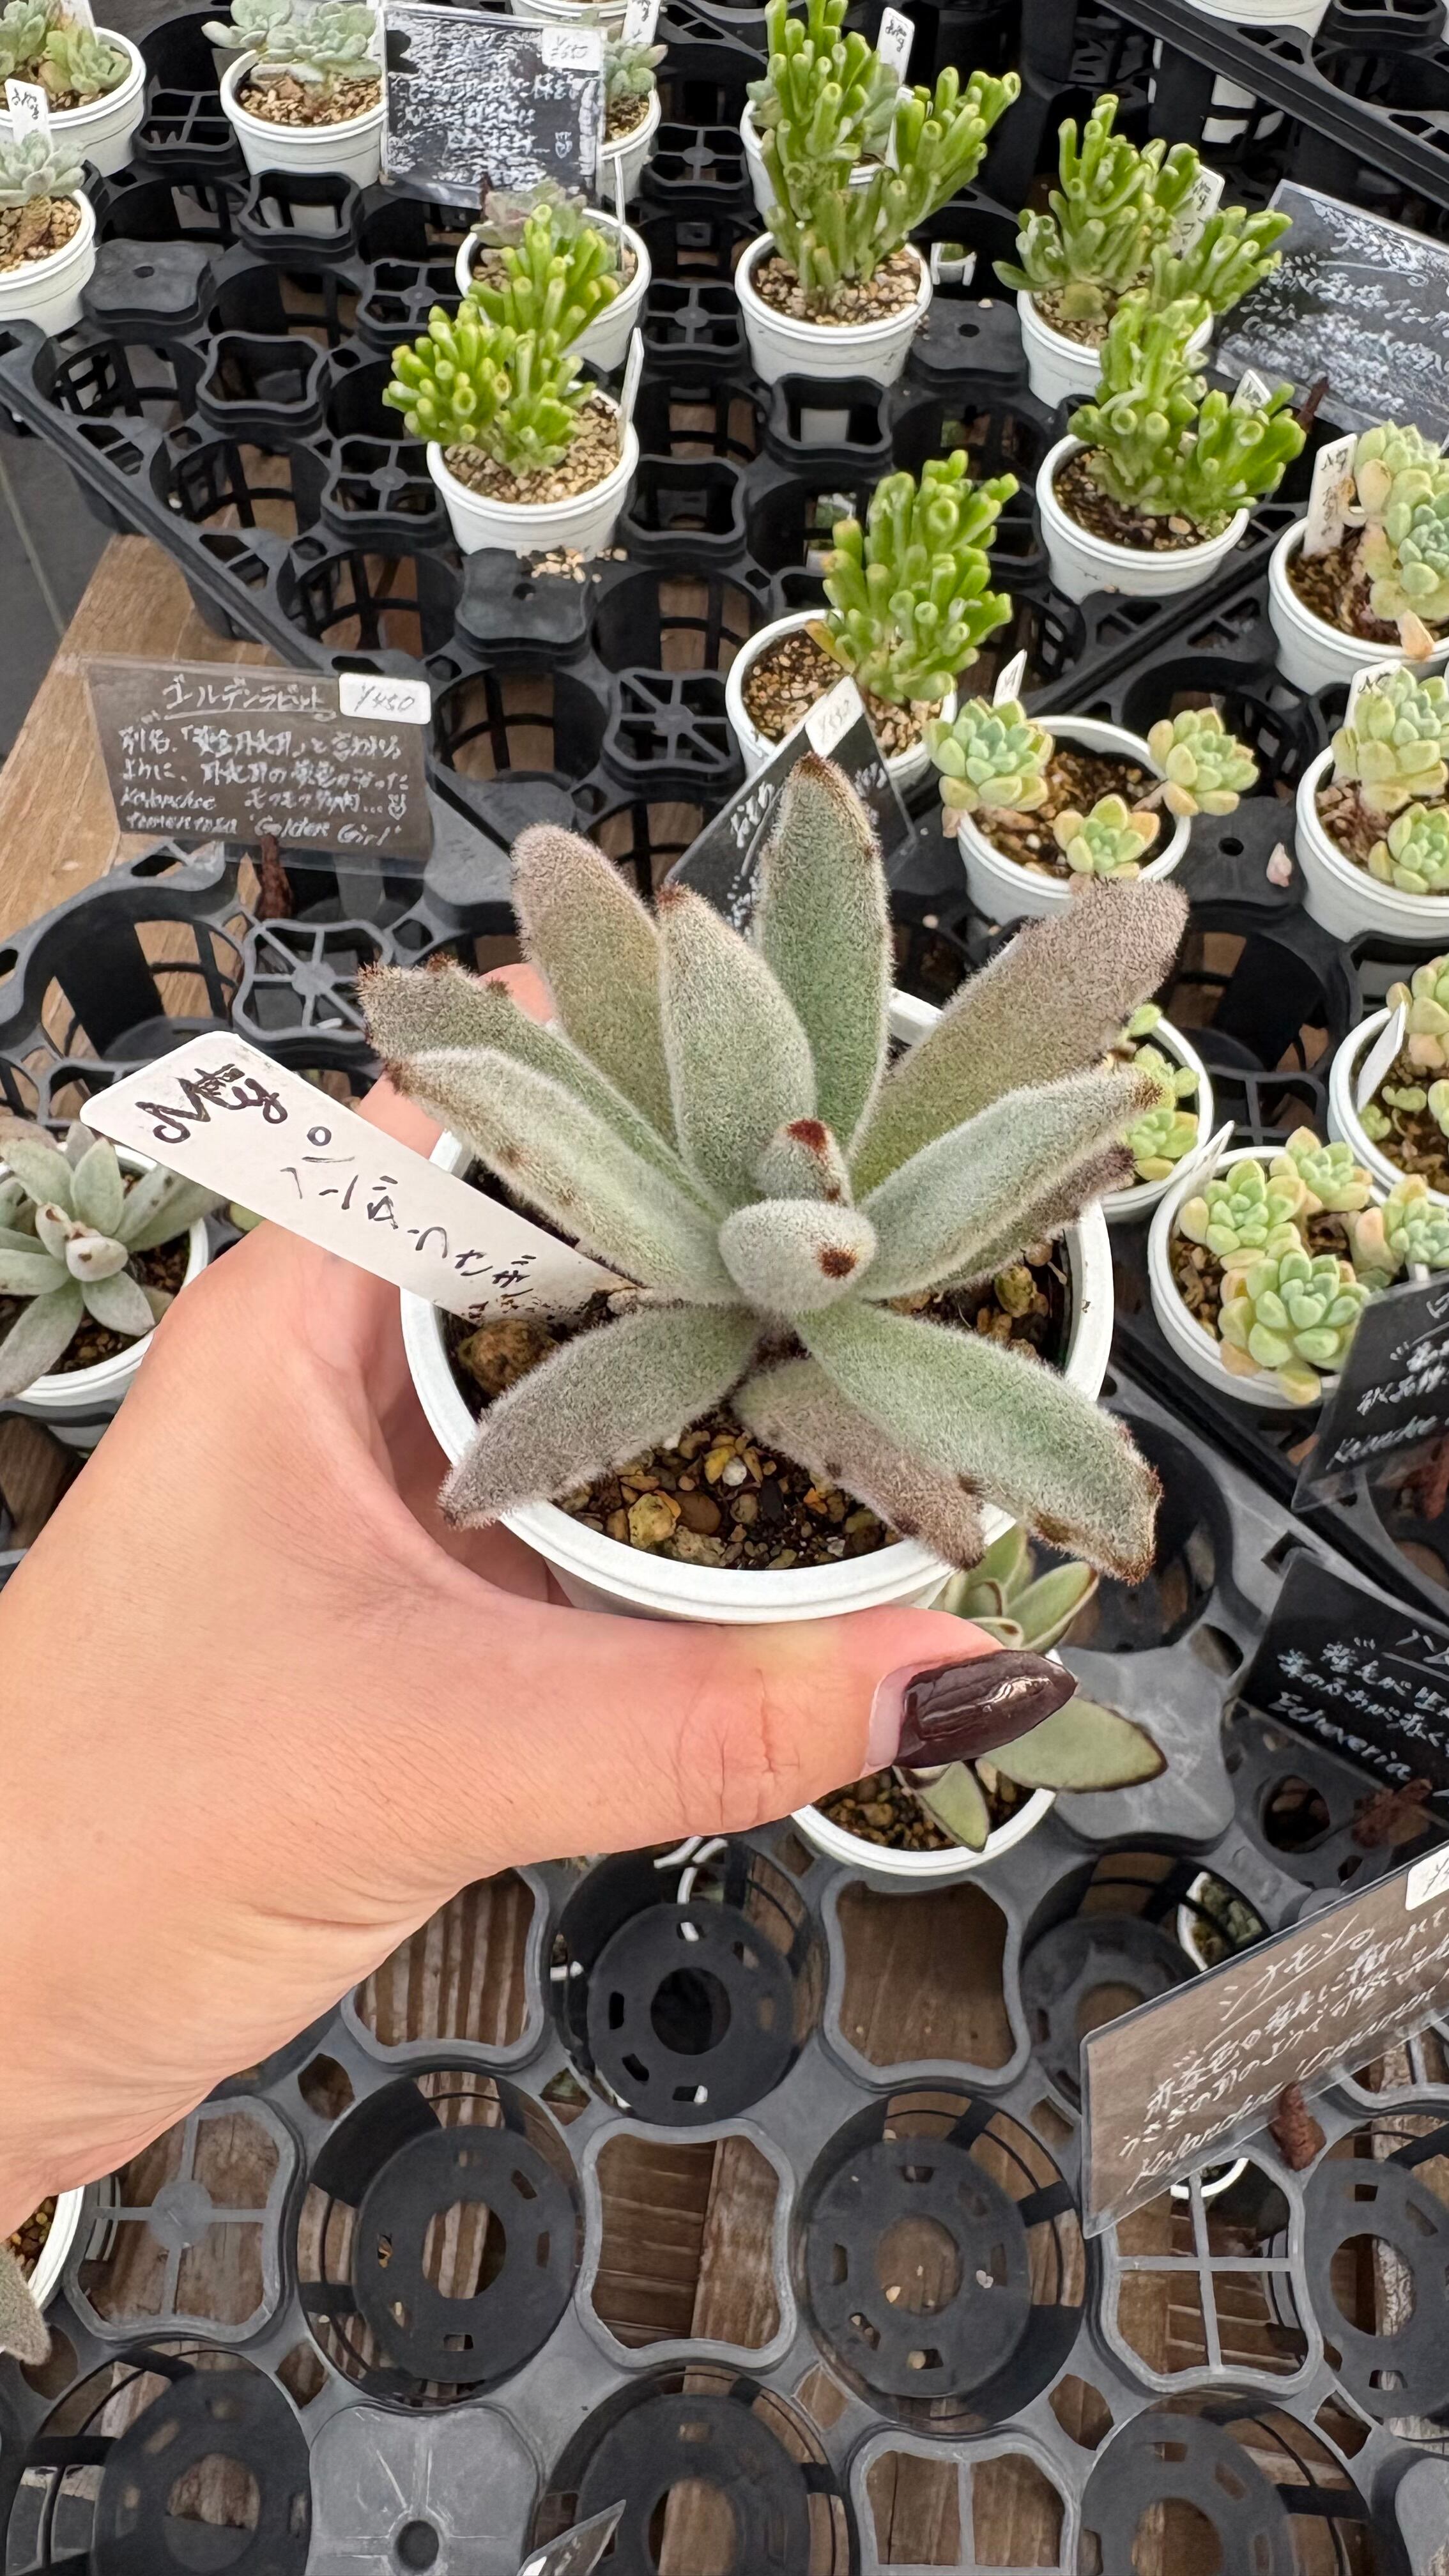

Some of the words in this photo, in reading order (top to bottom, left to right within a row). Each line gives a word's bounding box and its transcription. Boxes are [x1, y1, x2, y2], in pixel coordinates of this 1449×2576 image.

[162, 673, 325, 712] ゴールデンラビット
[279, 1125, 537, 1298] パンダうさぎ
